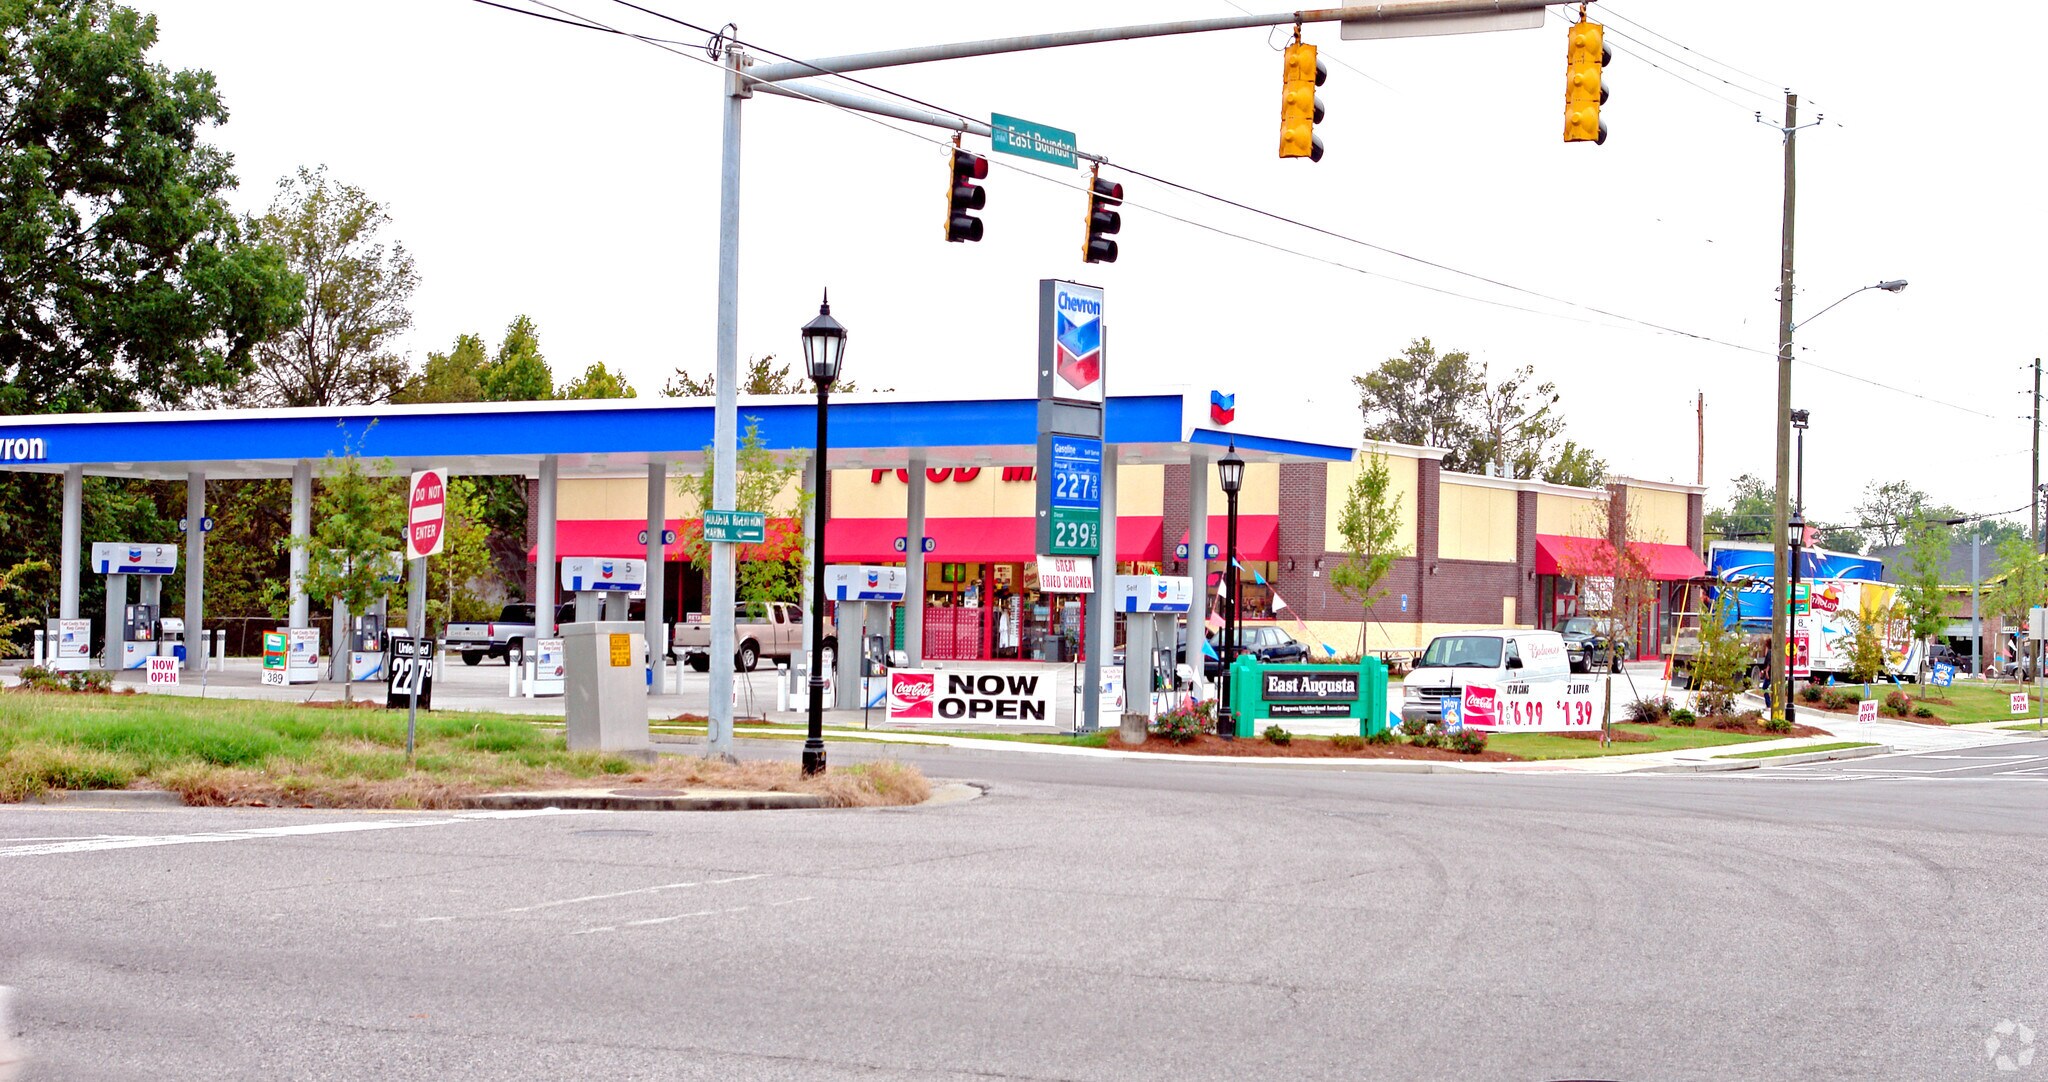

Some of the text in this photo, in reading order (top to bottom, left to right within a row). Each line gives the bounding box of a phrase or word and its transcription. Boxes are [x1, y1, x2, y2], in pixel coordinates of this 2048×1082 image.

[1008, 125, 1032, 150] East
[1034, 132, 1076, 165] Boundary
[1057, 291, 1100, 316] Chevron
[1054, 443, 1077, 455] Gasoline
[1056, 473, 1090, 499] 227
[415, 484, 442, 502] DO NOT
[415, 524, 437, 541] ENTER
[1055, 522, 1090, 548] 239
[155, 547, 163, 557] 9
[572, 564, 583, 572] Self
[625, 562, 632, 573] 5
[1055, 559, 1076, 573] GREAT
[836, 573, 848, 581] Self
[889, 570, 896, 581] 3
[1041, 574, 1092, 590] FRIED CHICKEN
[1125, 584, 1138, 592] Self
[398, 642, 429, 656] Unleed
[152, 660, 175, 670] NOW
[1936, 664, 1952, 673] play
[151, 672, 177, 683] OPEN
[267, 672, 284, 685] 389
[948, 674, 1039, 696] NOW
[1267, 675, 1356, 697] East Augusta
[1567, 684, 1590, 695] 2 LITER
[1443, 697, 1459, 710] play
[2013, 695, 2026, 703] NOW
[938, 698, 1046, 721] OPEN
[1497, 700, 1504, 726] 2
[1510, 700, 1543, 726] $6.99
[1556, 700, 1593, 726] $1.39
[1861, 702, 1876, 712] NOW
[2012, 703, 2027, 711] OPEN
[1859, 712, 1876, 722] OPEN
